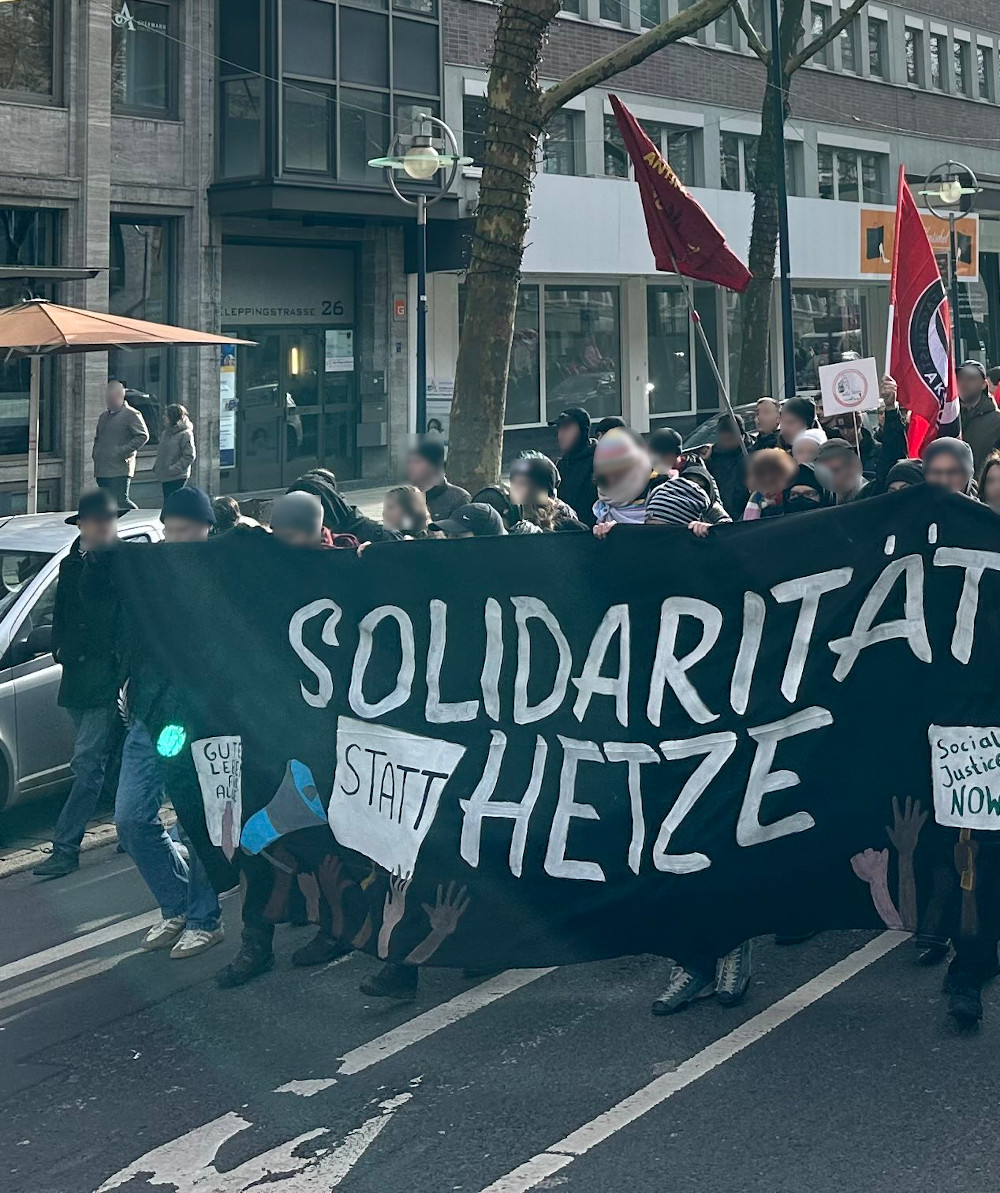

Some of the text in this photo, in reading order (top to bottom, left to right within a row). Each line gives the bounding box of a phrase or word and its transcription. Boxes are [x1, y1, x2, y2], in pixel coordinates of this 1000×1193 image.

[221, 300, 344, 317] LEPPINGSTRASSE 26
[341, 705, 835, 882] STATT HETZE
